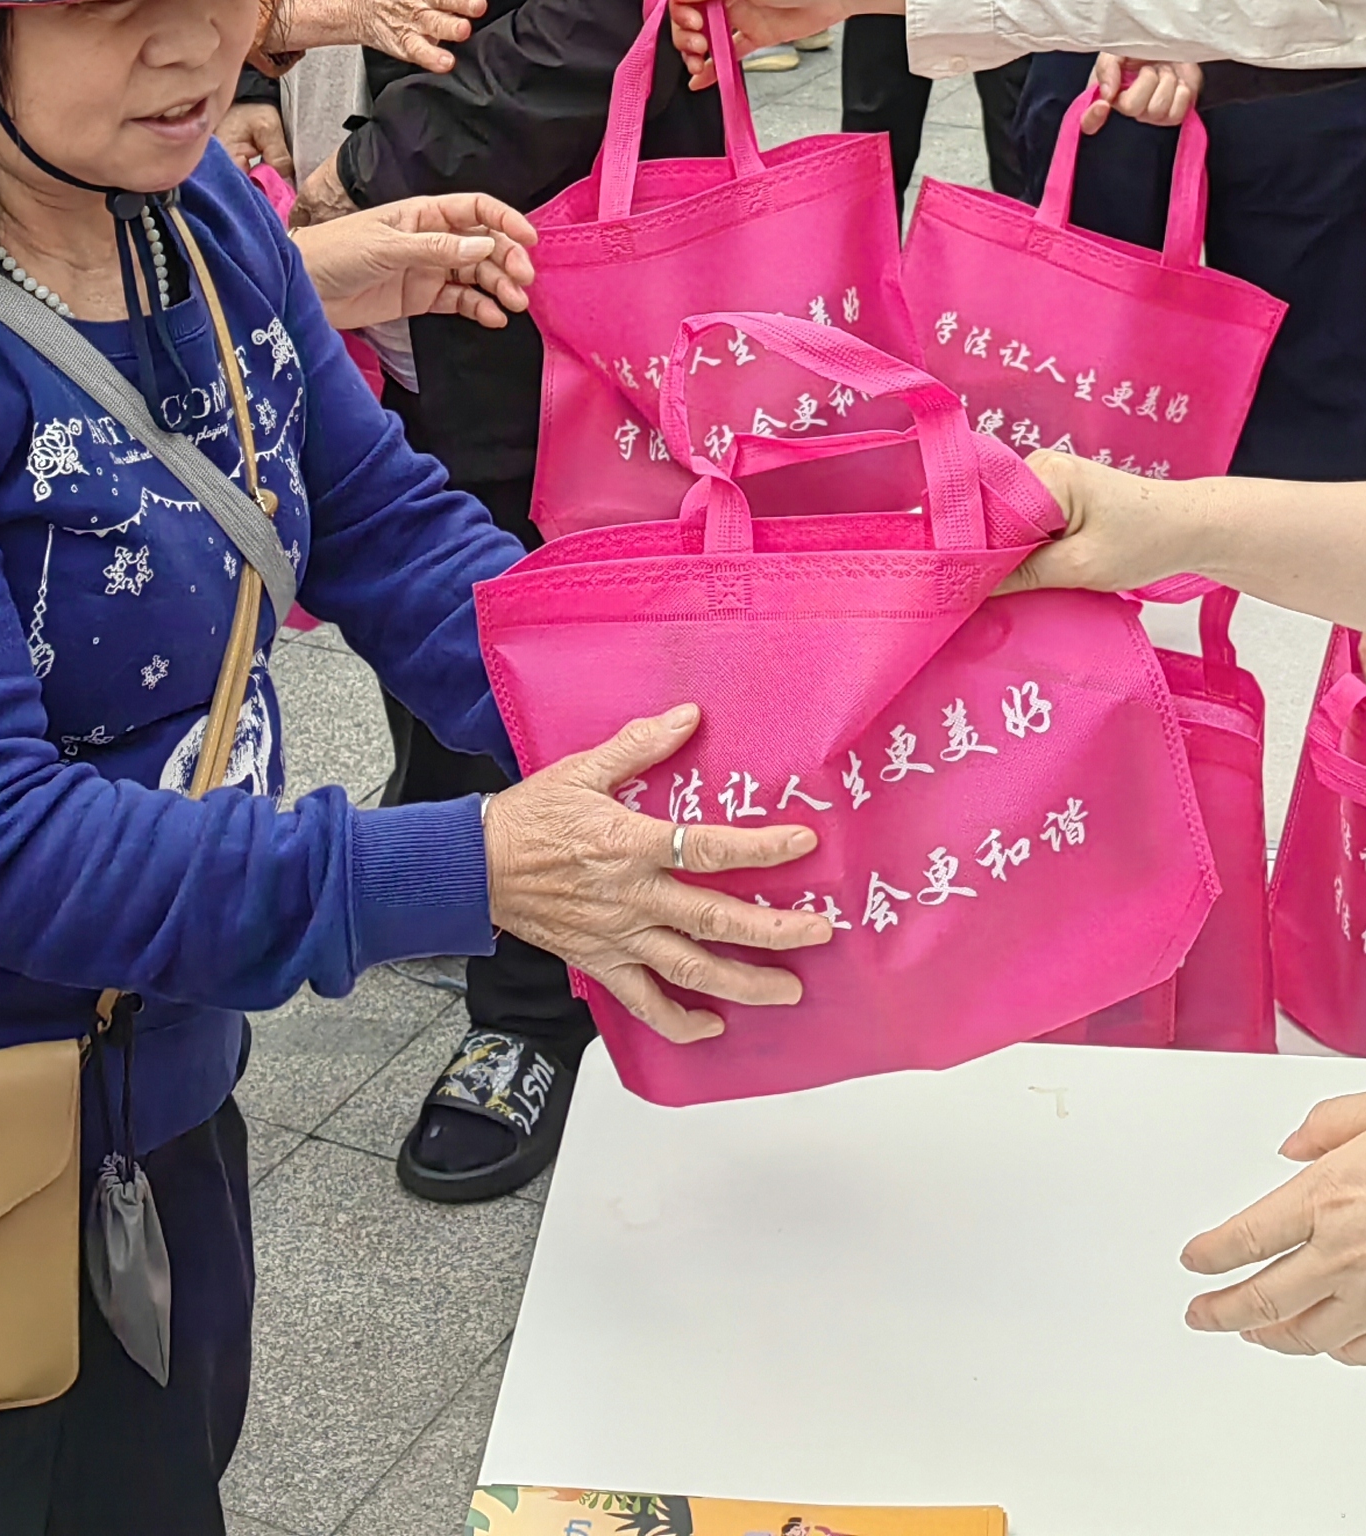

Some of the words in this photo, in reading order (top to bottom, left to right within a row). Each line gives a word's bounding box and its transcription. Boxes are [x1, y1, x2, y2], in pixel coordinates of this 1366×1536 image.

[935, 311, 1189, 423] 学法让人生更美好
